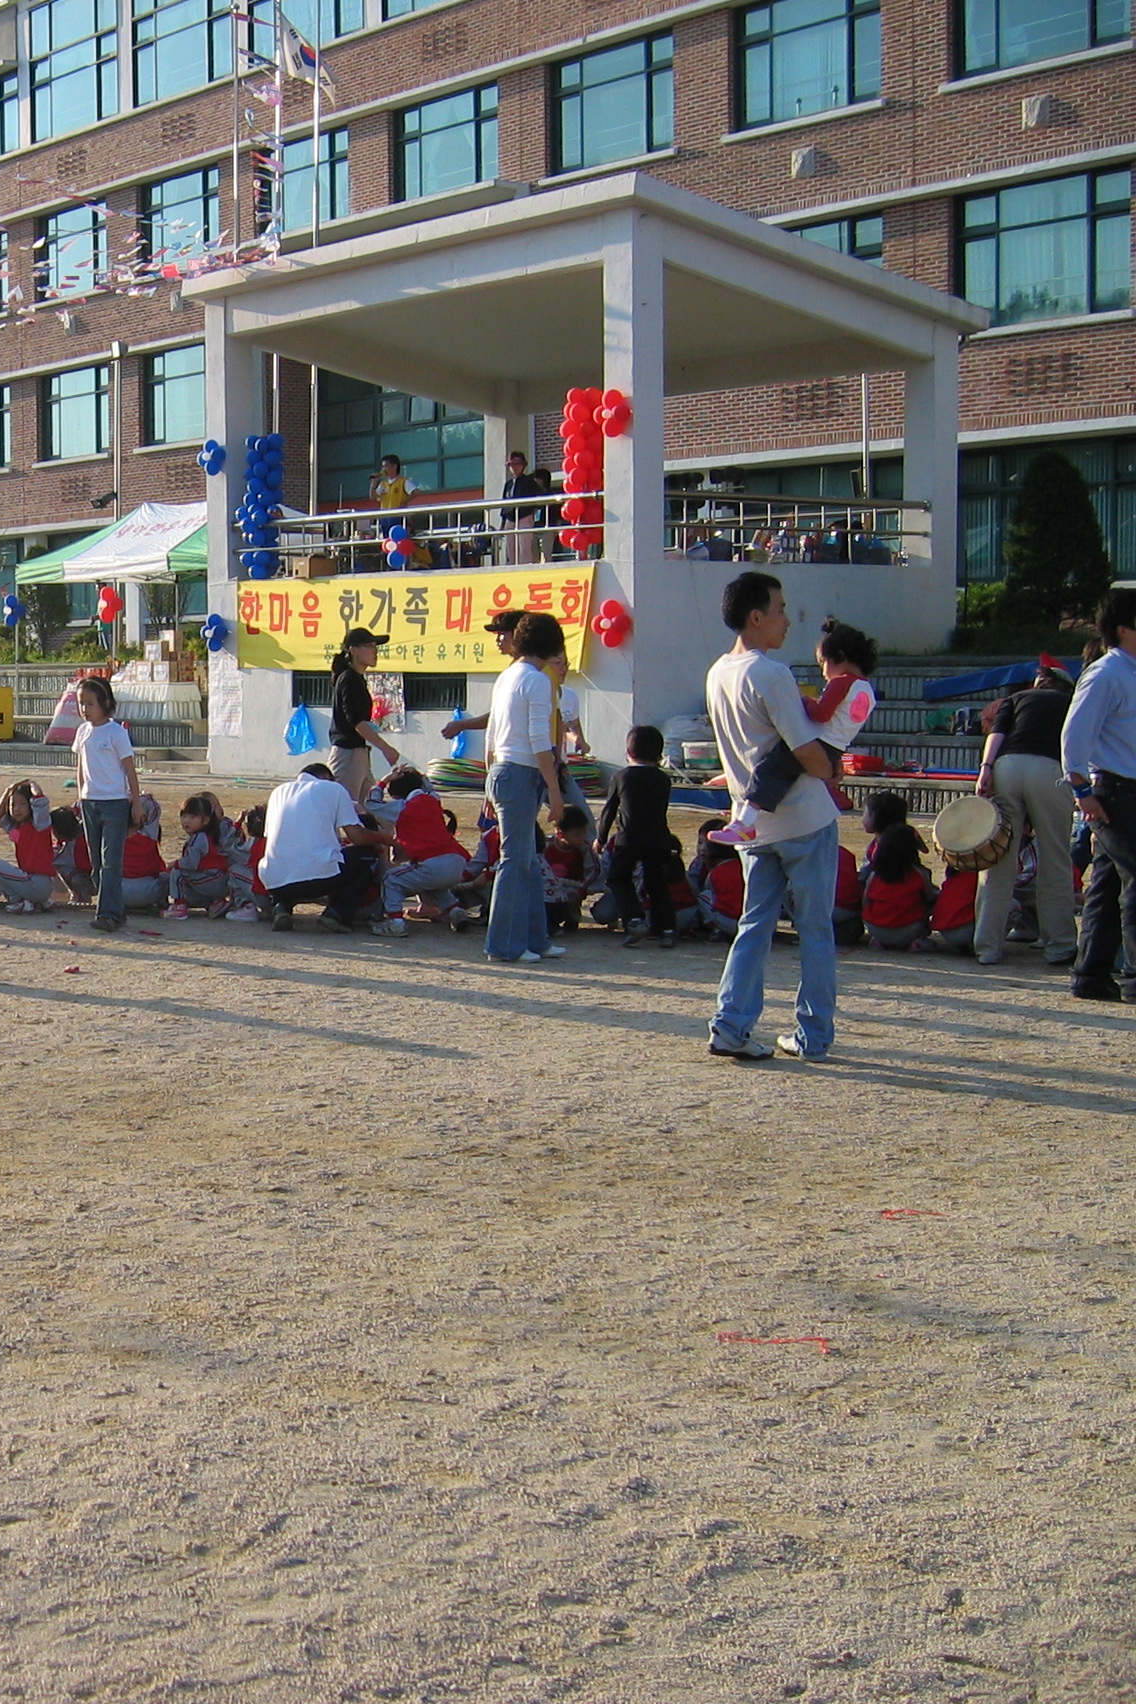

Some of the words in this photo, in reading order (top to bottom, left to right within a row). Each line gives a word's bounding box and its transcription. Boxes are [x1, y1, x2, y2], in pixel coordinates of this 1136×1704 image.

[240, 590, 322, 638] 한마음
[338, 587, 430, 635] 한가족
[436, 641, 485, 664] 유치원
